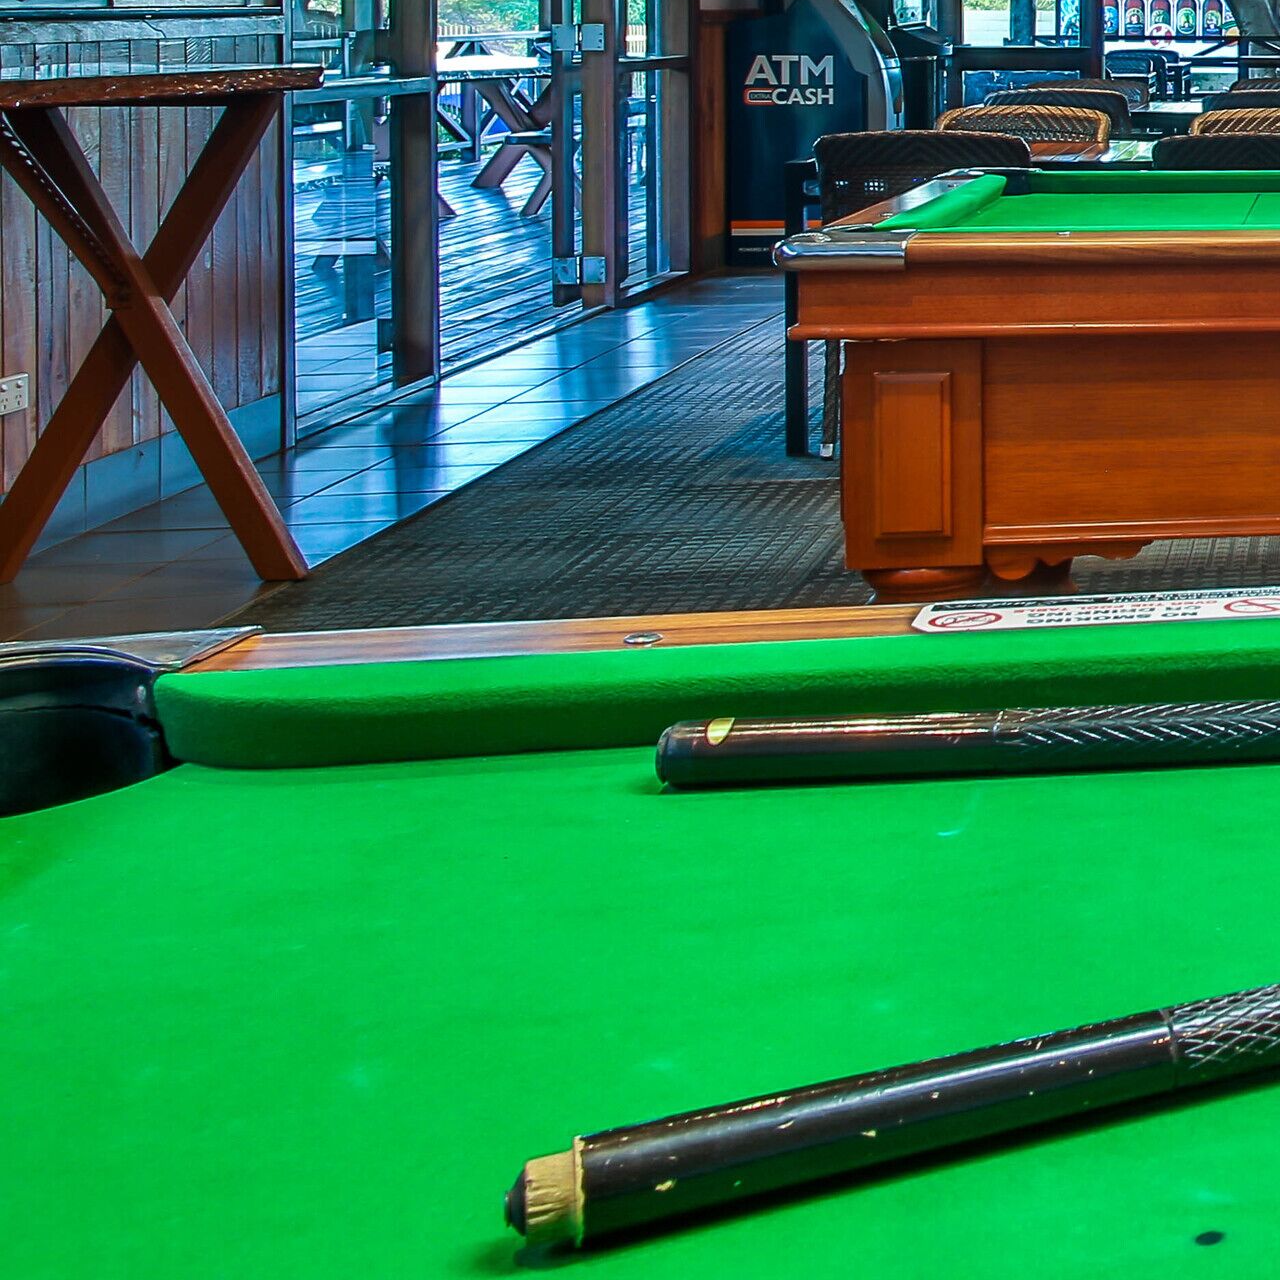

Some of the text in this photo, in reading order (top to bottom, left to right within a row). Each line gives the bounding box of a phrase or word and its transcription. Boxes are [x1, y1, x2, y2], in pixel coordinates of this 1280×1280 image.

[744, 55, 834, 85] ATM
[771, 88, 834, 105] CASH
[1171, 599, 1219, 607] OVER
[1013, 606, 1069, 614] TABLE
[1027, 607, 1156, 618] DRINKING
[1026, 613, 1152, 624] SMOKING
